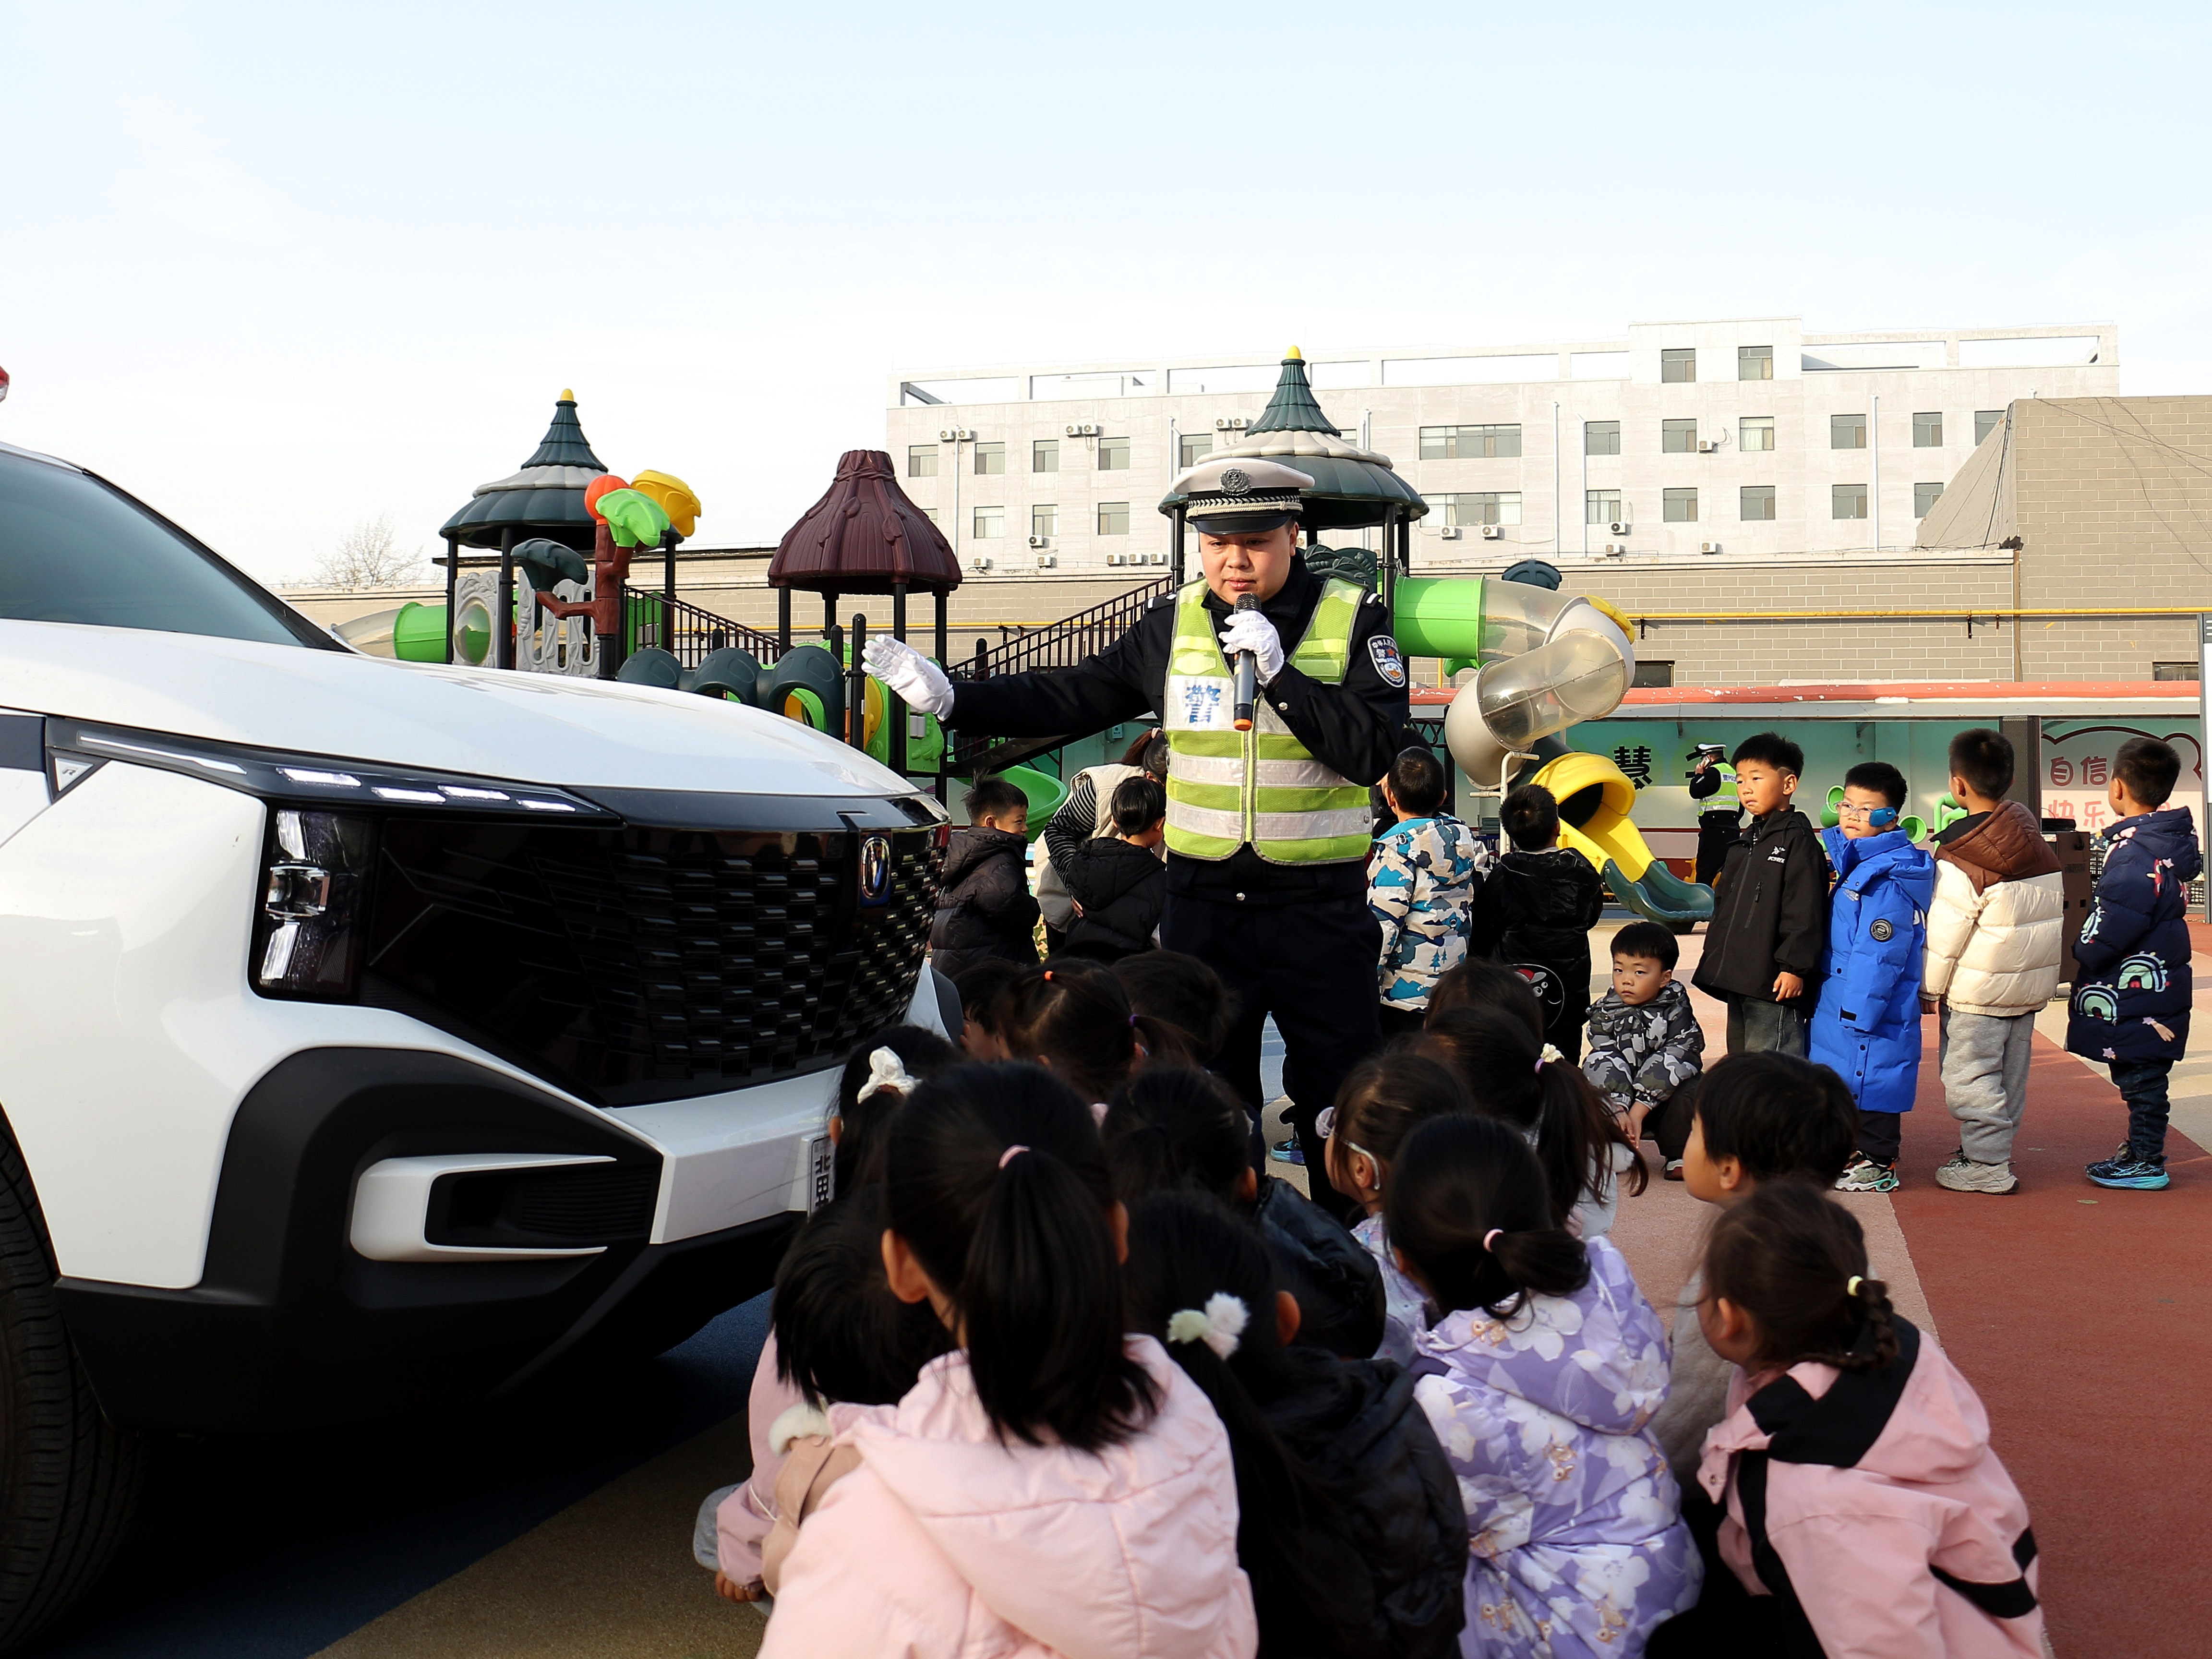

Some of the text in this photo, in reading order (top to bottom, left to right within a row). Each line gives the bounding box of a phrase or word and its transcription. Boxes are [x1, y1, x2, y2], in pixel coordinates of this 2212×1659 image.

[1185, 685, 1221, 723] 警
[1613, 745, 1652, 790] 慧
[2050, 756, 2107, 786] 自信
